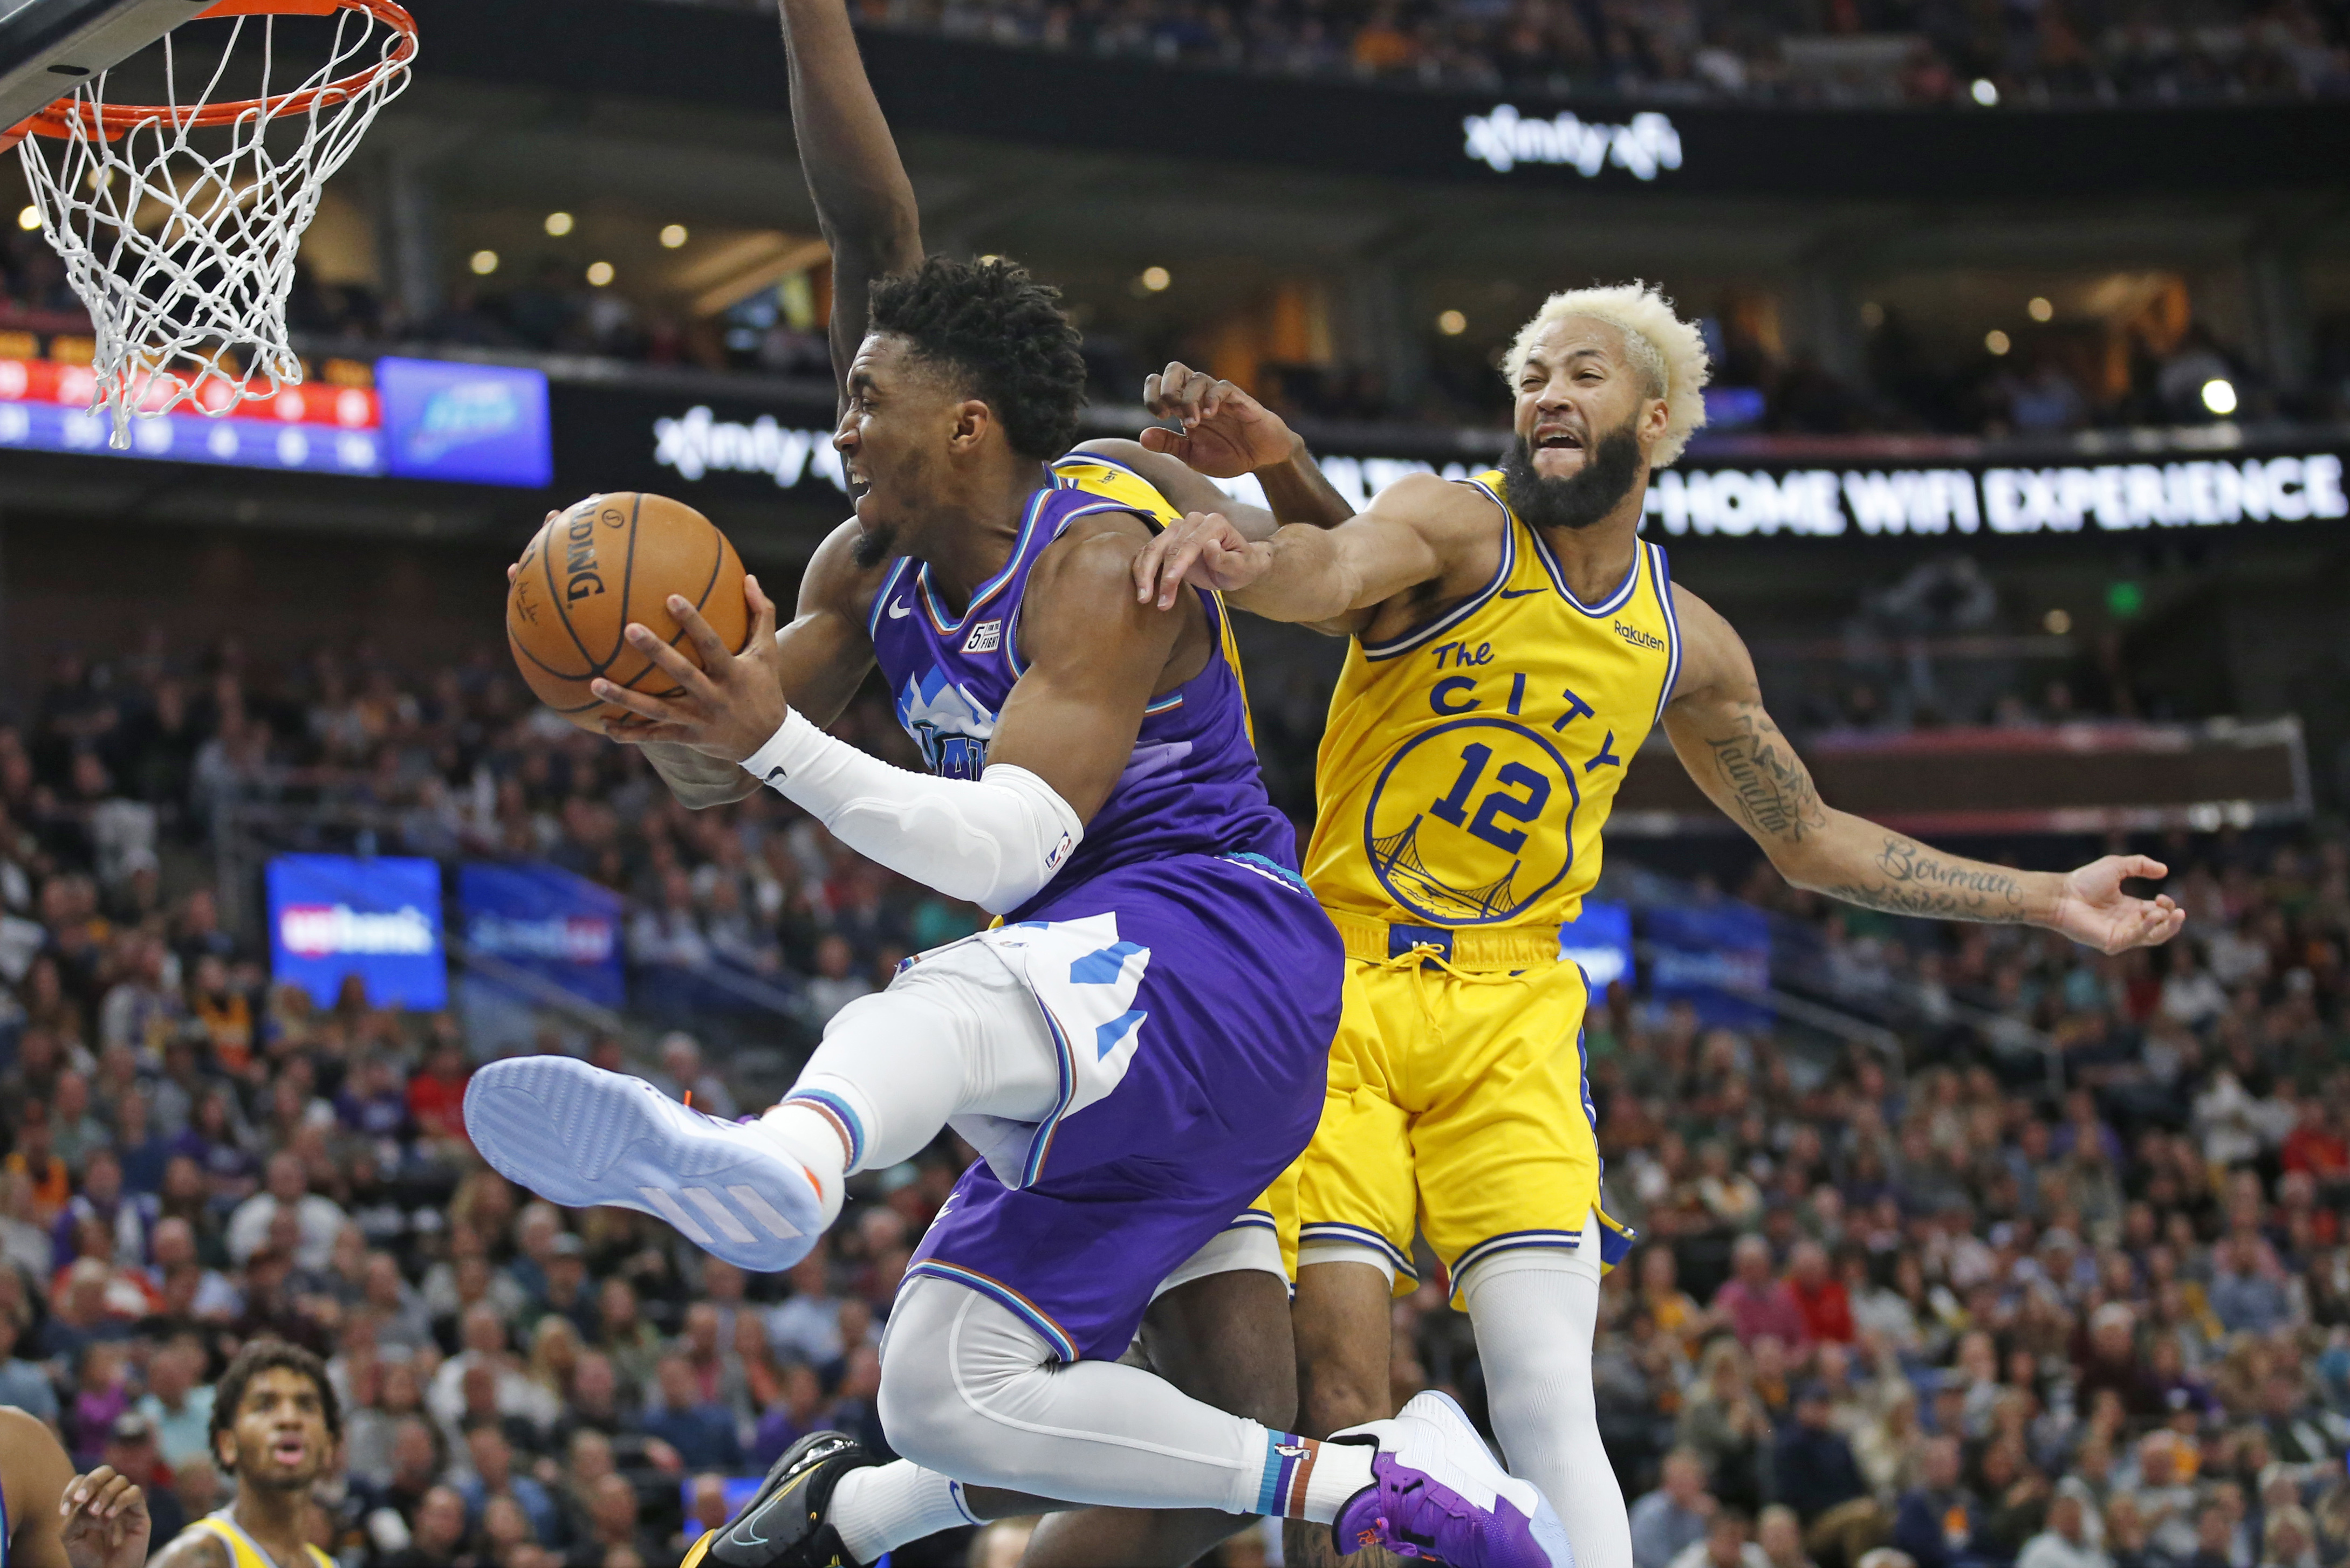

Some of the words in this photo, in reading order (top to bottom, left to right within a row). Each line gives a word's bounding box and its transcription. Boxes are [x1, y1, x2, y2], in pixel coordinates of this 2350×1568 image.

[1982, 455, 2348, 533] EXPERIENCE
[968, 626, 985, 649] 5
[981, 636, 999, 649] FIGHT
[1433, 641, 1494, 669] The
[1614, 620, 1665, 652] Rakuten
[1429, 672, 1620, 773] CITY
[1429, 742, 1552, 855] 12
[1876, 835, 2022, 905] Bowman
